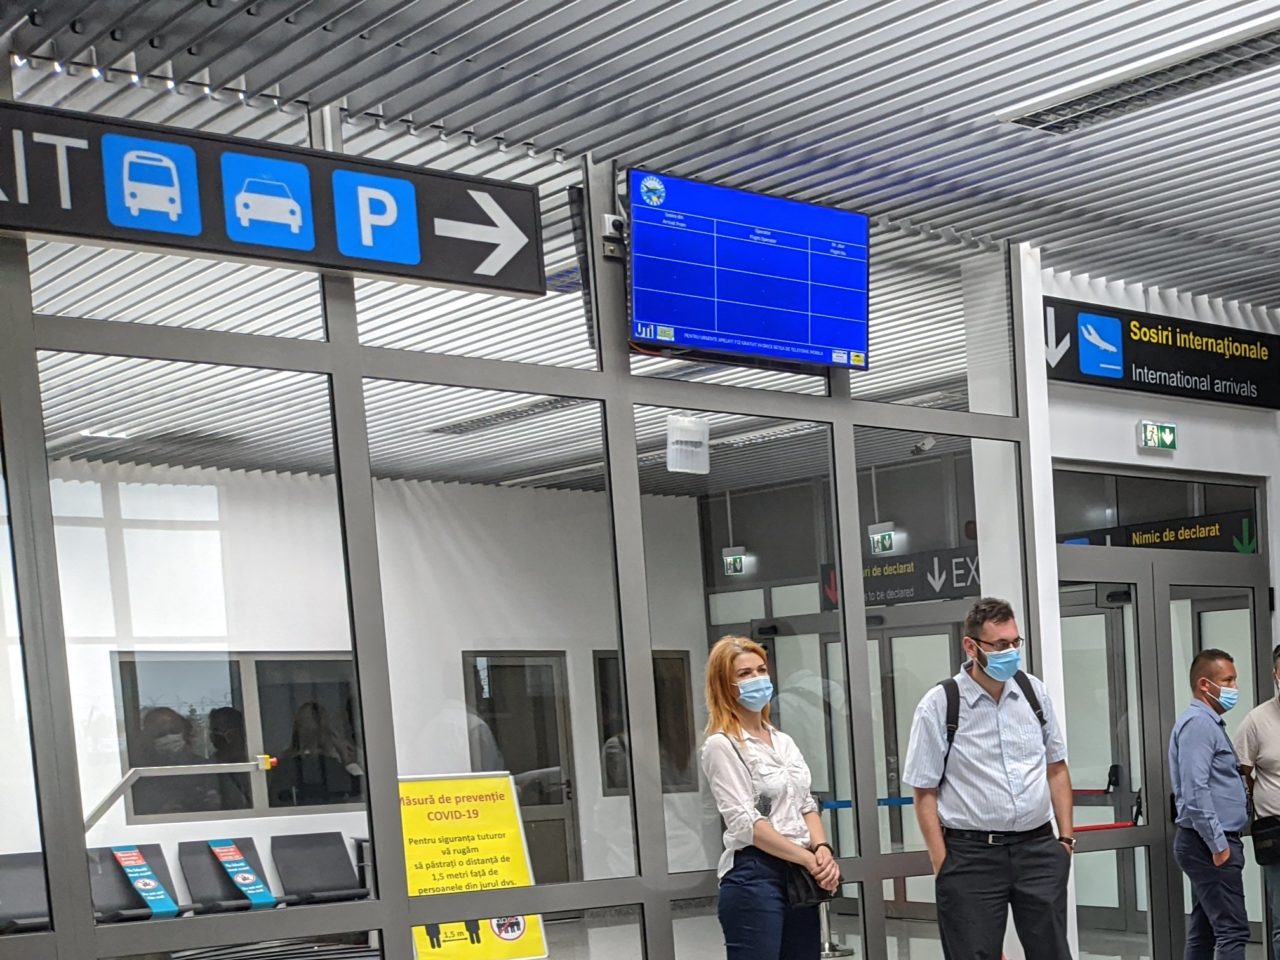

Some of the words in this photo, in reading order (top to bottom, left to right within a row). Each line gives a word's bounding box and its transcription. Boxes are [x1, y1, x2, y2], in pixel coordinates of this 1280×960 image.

[0, 129, 88, 209] IT
[357, 185, 397, 247] P
[1130, 320, 1172, 345] Sosiri
[1132, 363, 1210, 391] International
[1214, 378, 1258, 398] arrivals
[1132, 530, 1160, 545] Nimic
[1163, 527, 1176, 541] de
[1178, 522, 1221, 540] declarat
[872, 565, 882, 576] de
[883, 562, 914, 575] declarat
[886, 587, 914, 598] declared
[438, 794, 452, 804] de
[427, 809, 479, 821] COVID-19
[408, 837, 436, 845] Pentru
[477, 832, 506, 840] tuturor
[441, 847, 451, 855] vă
[453, 846, 479, 856] rugăm
[500, 855, 511, 863] de
[432, 873, 444, 881] 1,5
[446, 870, 469, 879] metri
[488, 868, 499, 876] de
[418, 884, 463, 895] persoanele
[465, 882, 479, 890] din
[480, 880, 499, 890] jurul
[500, 879, 517, 887] dvs.
